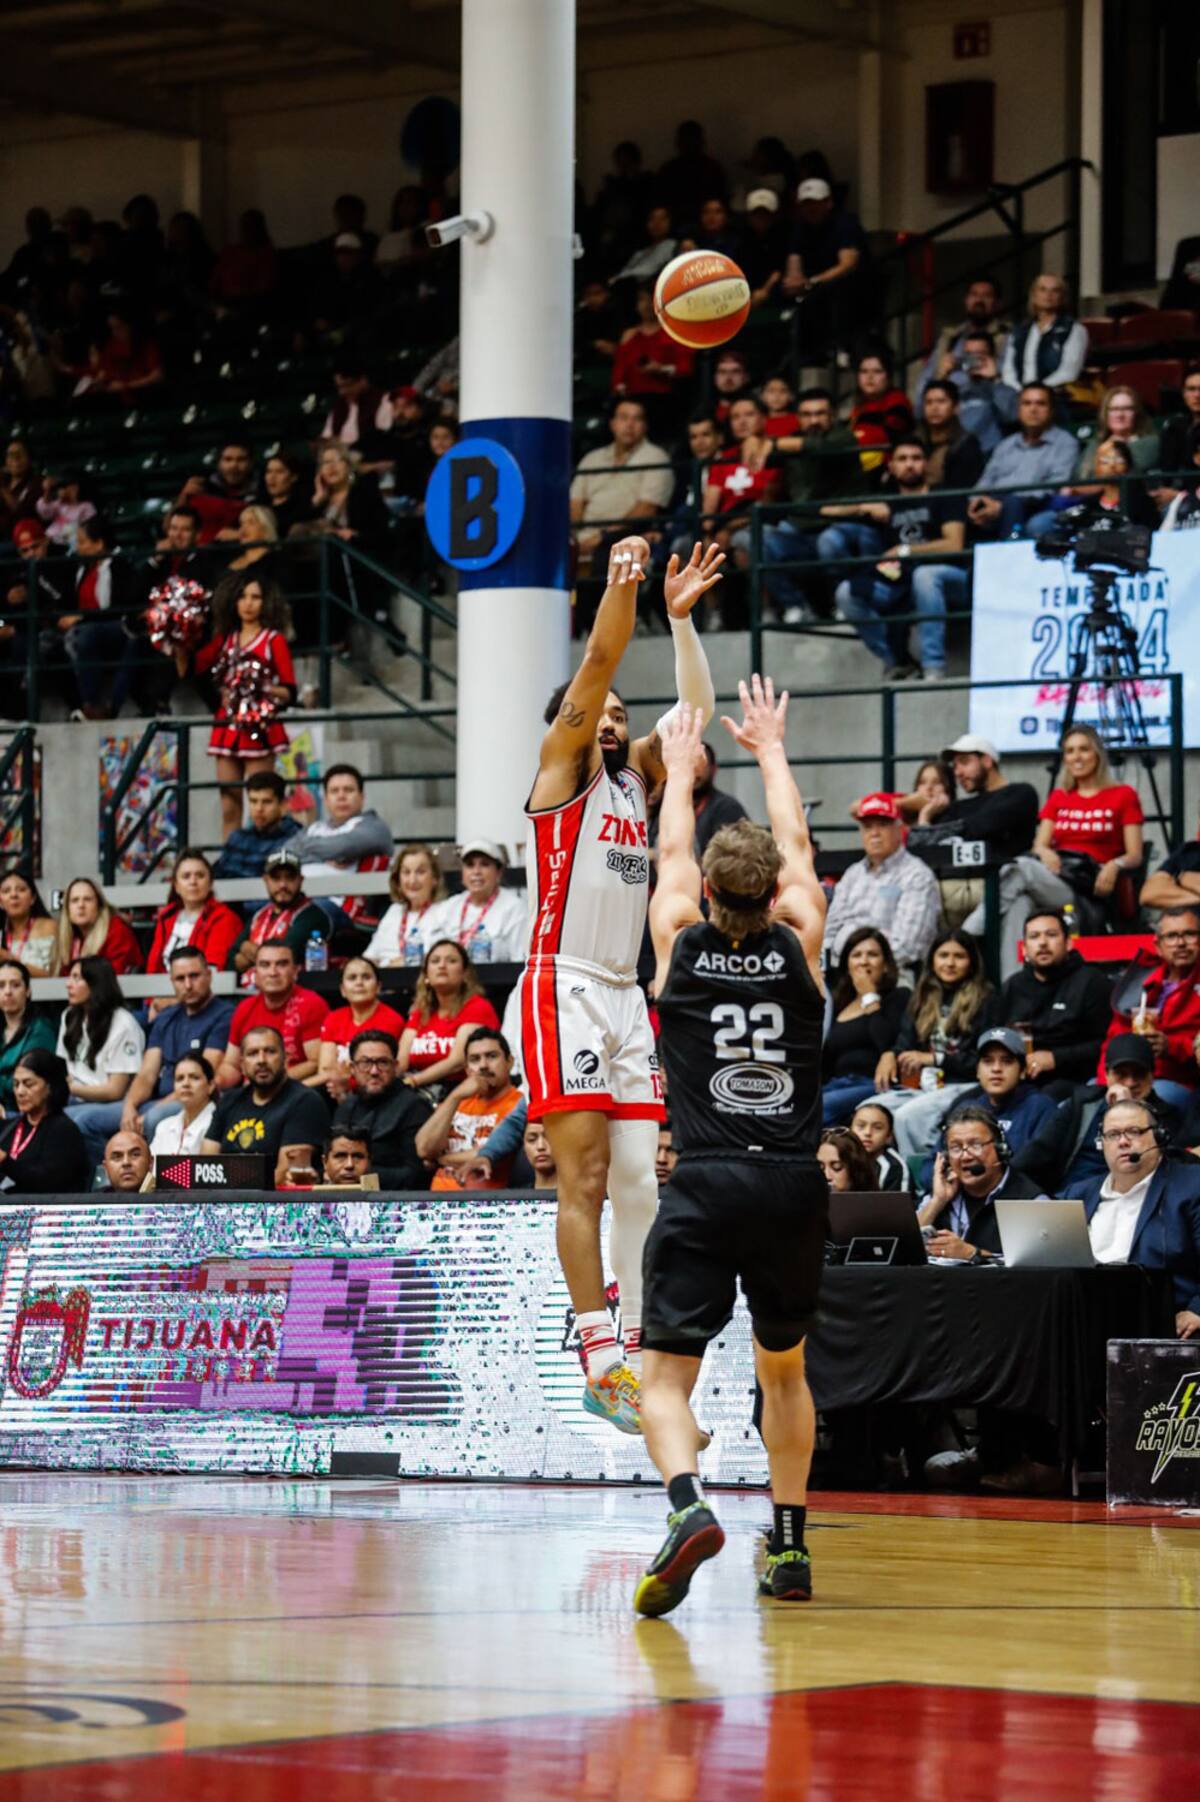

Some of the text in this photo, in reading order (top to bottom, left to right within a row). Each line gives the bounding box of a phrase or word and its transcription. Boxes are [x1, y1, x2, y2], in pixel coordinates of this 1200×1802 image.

[449, 456, 498, 558] B
[694, 951, 761, 974] ARCO
[711, 1003, 786, 1062] 22
[565, 1077, 606, 1090] MEGA
[195, 1163, 227, 1184] POSS.
[99, 1319, 277, 1350] TIJUANA
